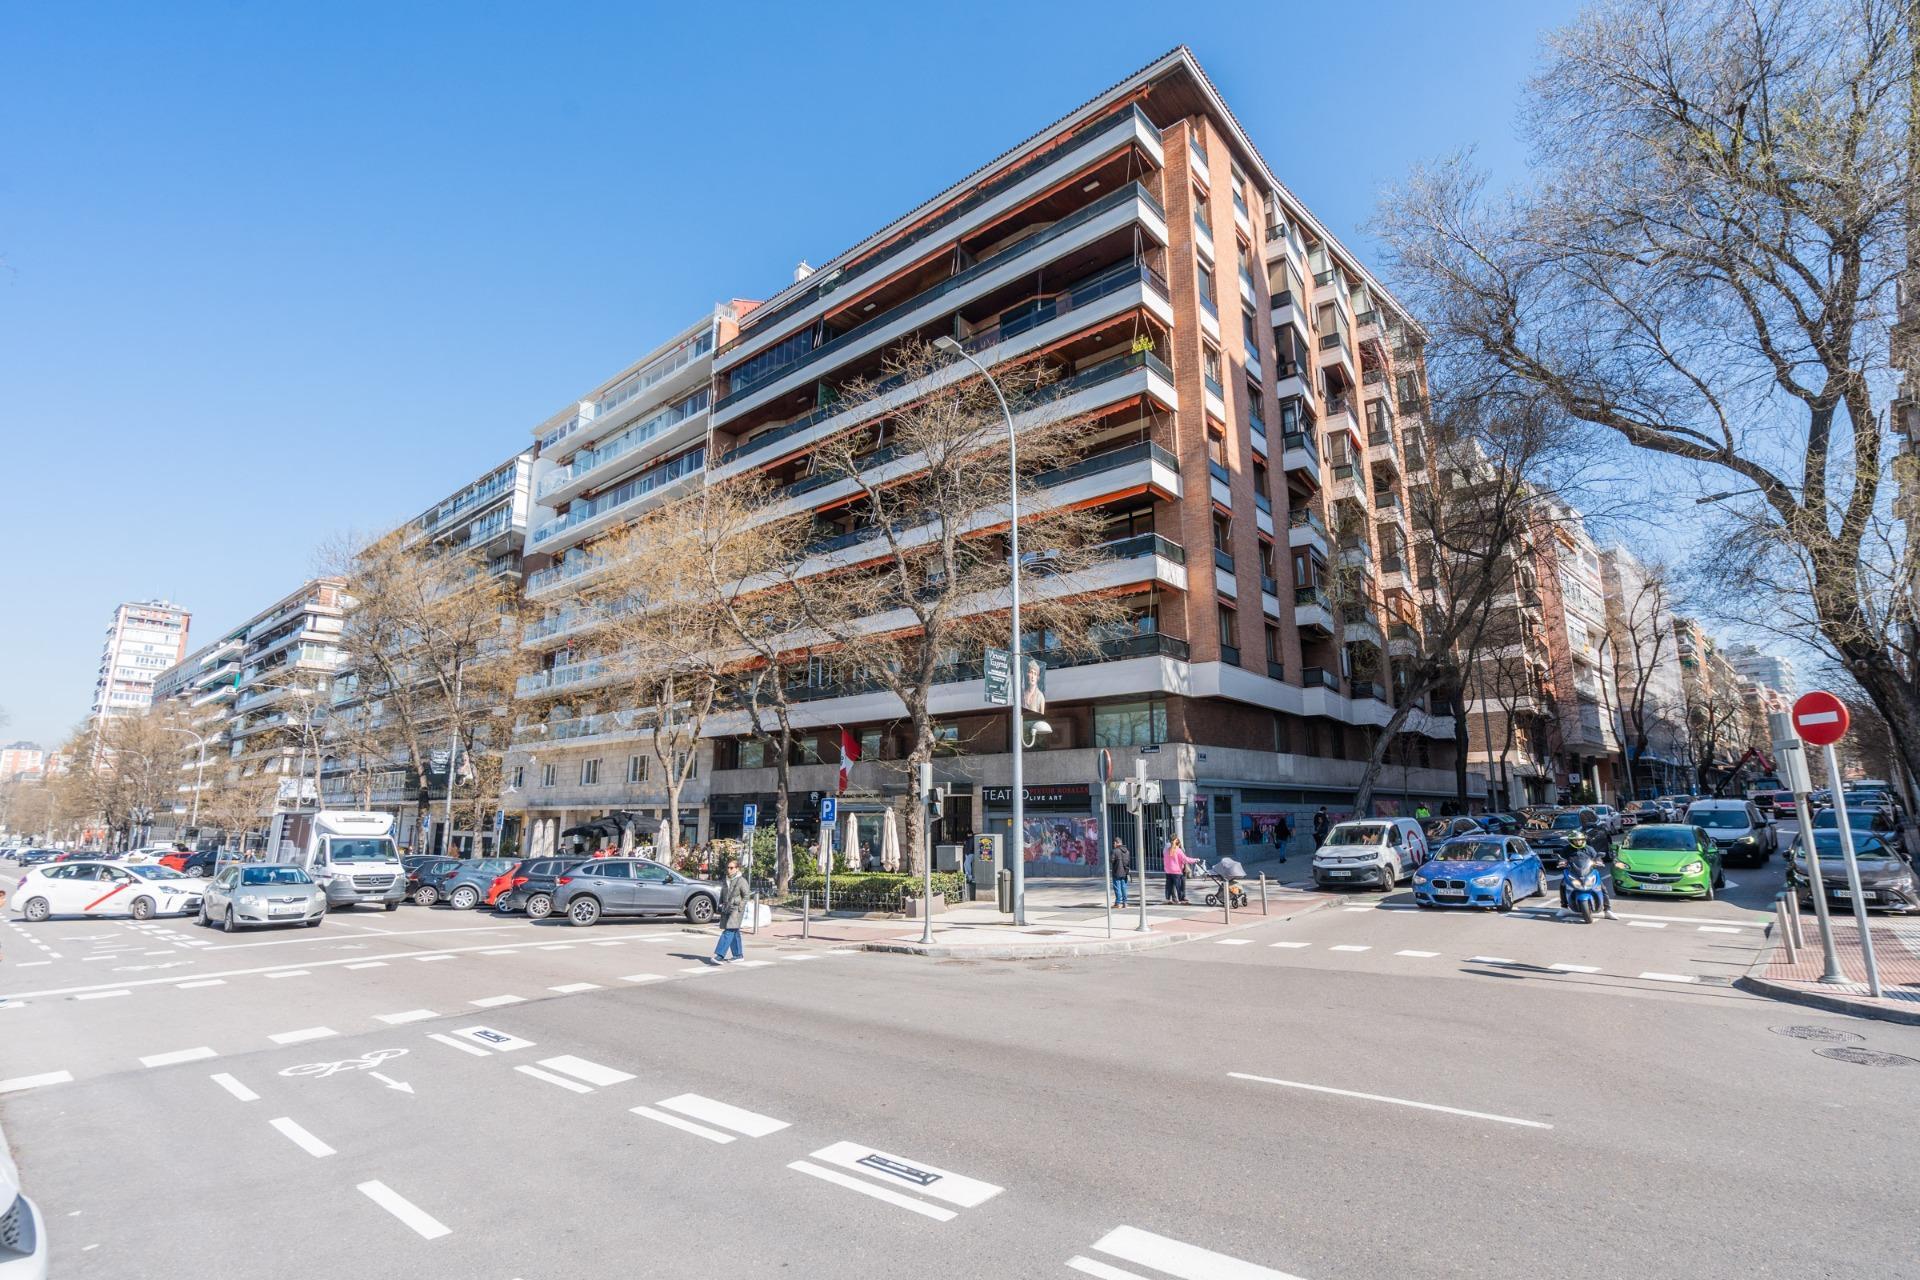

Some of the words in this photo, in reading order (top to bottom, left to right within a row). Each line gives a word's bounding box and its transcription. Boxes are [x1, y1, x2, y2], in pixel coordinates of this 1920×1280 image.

[982, 789, 1030, 801] TEATO
[745, 806, 753, 823] P
[823, 800, 832, 818] P
